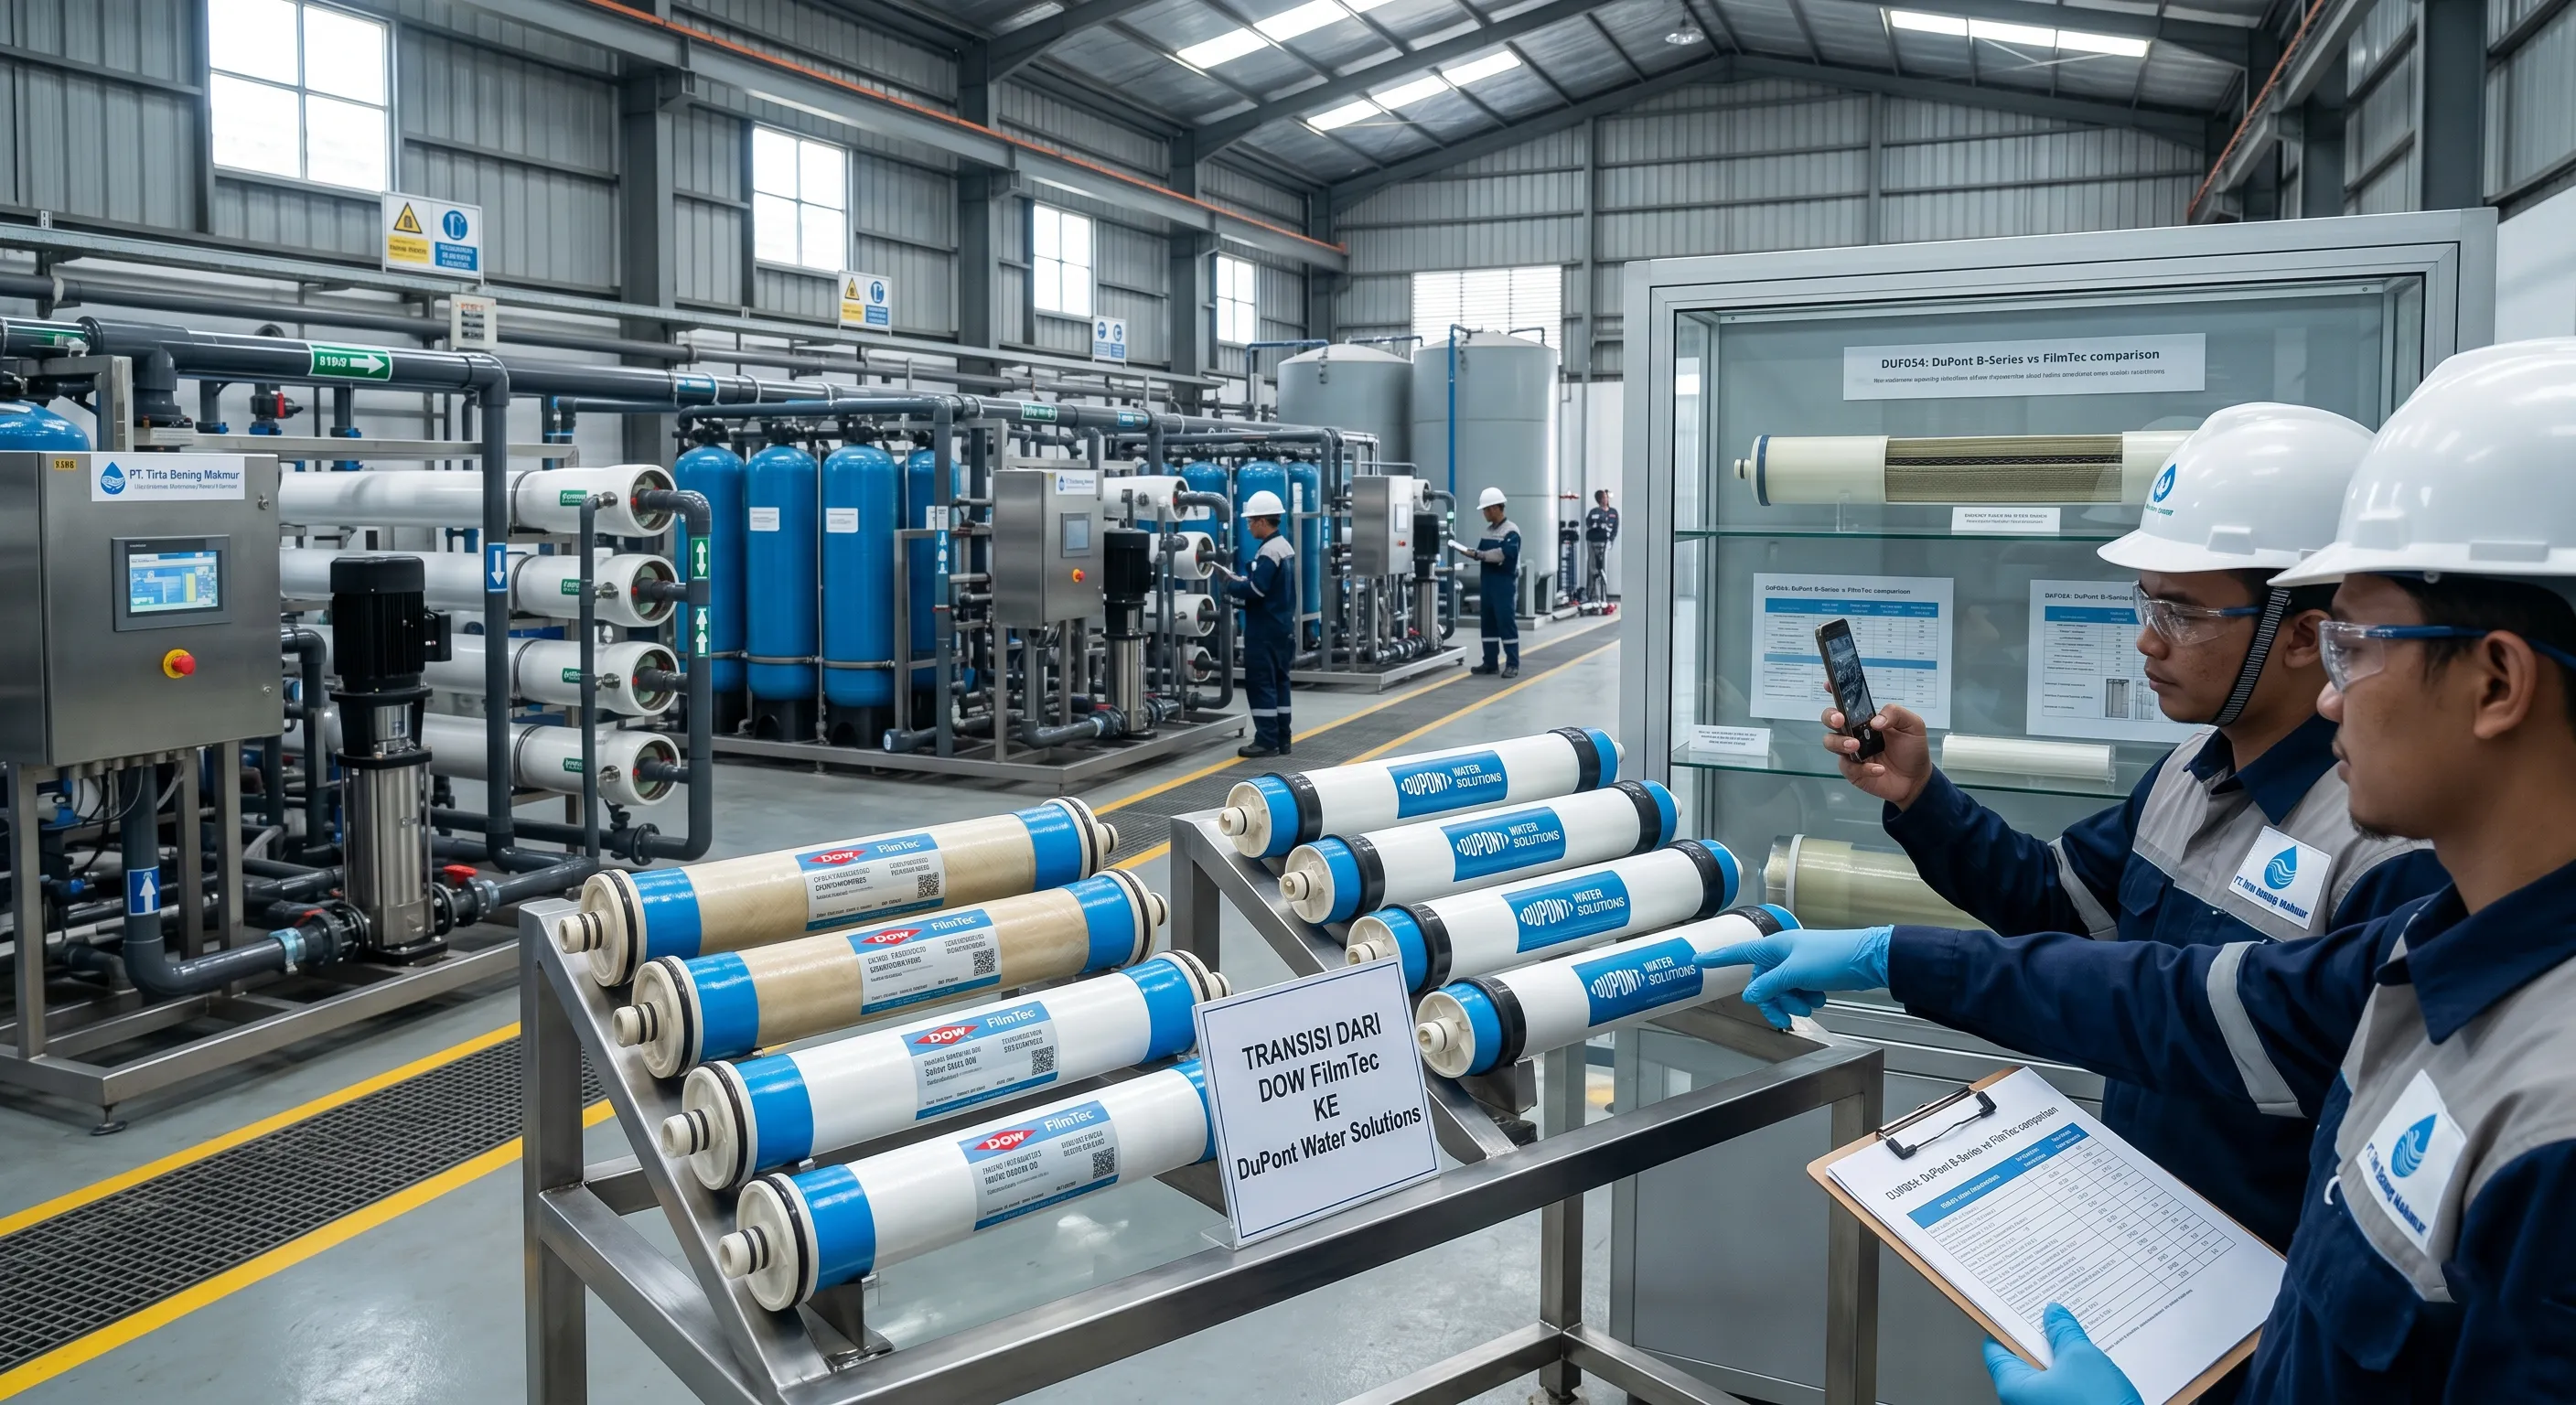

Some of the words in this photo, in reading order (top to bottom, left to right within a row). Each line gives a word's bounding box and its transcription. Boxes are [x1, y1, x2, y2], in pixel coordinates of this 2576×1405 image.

[1881, 356, 1928, 369] DUF054:
[1932, 355, 1973, 367] DuPont
[1976, 353, 2023, 366] B-Series
[2027, 355, 2040, 364] vs
[2044, 351, 2088, 363] FilmTec
[2089, 349, 2161, 363] comparison
[129, 469, 144, 480] PT.
[146, 469, 167, 479] Tirta
[170, 470, 201, 481] Bening
[204, 470, 240, 480] Makmur
[1452, 764, 1481, 778] WATER
[1456, 772, 1502, 788] SOLUTIONS
[1404, 772, 1448, 796] DUPONT
[1460, 831, 1506, 856] DUPONT
[1513, 831, 1560, 847] SOLUTIONS
[1572, 888, 1603, 904] WATER
[1577, 896, 1625, 917] SOLUTIONS
[1522, 898, 1571, 927] DUPONT
[931, 916, 977, 931] FilmTec
[1643, 957, 1674, 973] WATER
[1648, 964, 1696, 986] SOLUTIONS
[1594, 969, 1642, 999] DUPONT
[986, 1009, 1036, 1028] FilmTec
[1241, 1025, 1333, 1070] TRANSISI
[1336, 1012, 1382, 1046] DARI
[1259, 1067, 1305, 1103] DOW
[1310, 1052, 1379, 1088] FilmTec
[1314, 1093, 1341, 1121] KE
[1044, 1110, 1095, 1132] FilmTec
[1237, 1142, 1299, 1180] DuPont
[1300, 1130, 1347, 1160] Water
[1350, 1107, 1422, 1143] Solutions
